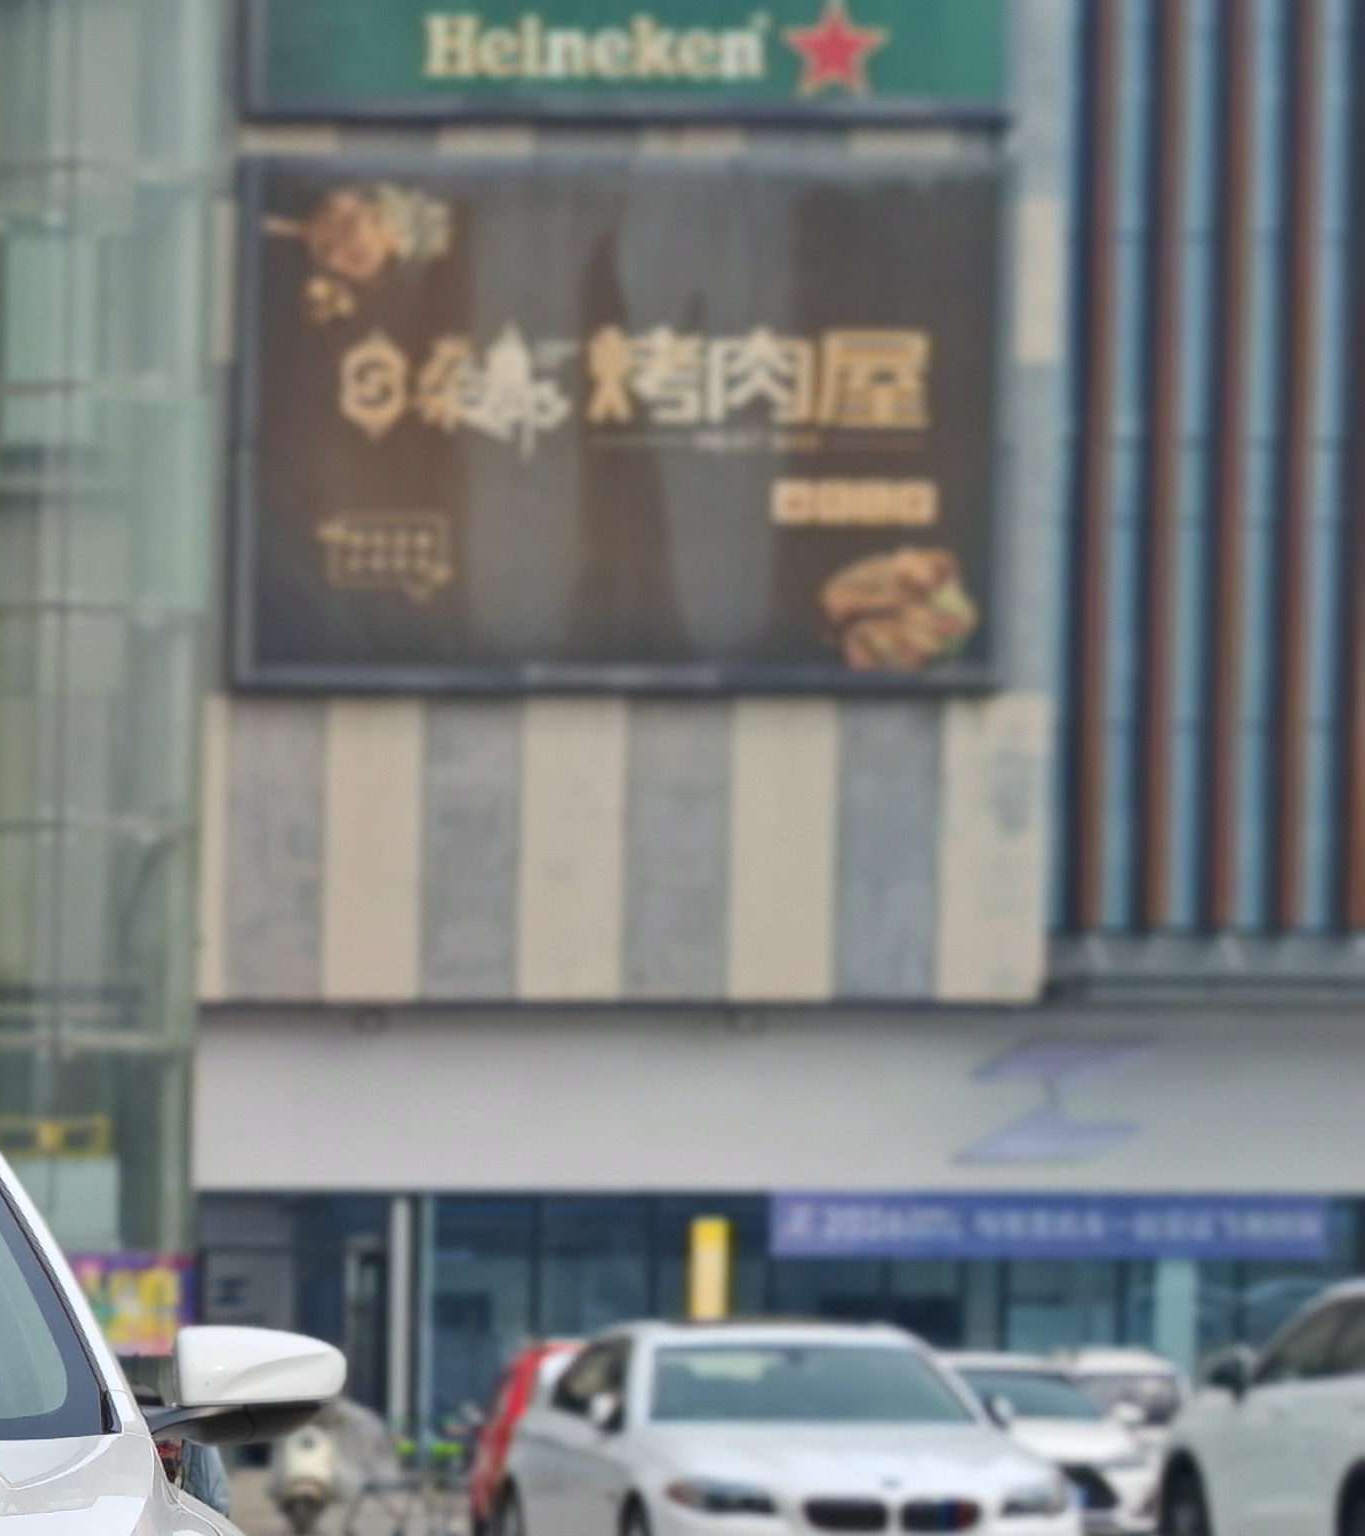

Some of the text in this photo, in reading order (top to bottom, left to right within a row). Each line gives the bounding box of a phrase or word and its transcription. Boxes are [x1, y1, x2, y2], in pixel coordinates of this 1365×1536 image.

[425, 13, 764, 80] Heineken
[586, 324, 932, 428] 烤肉屋
